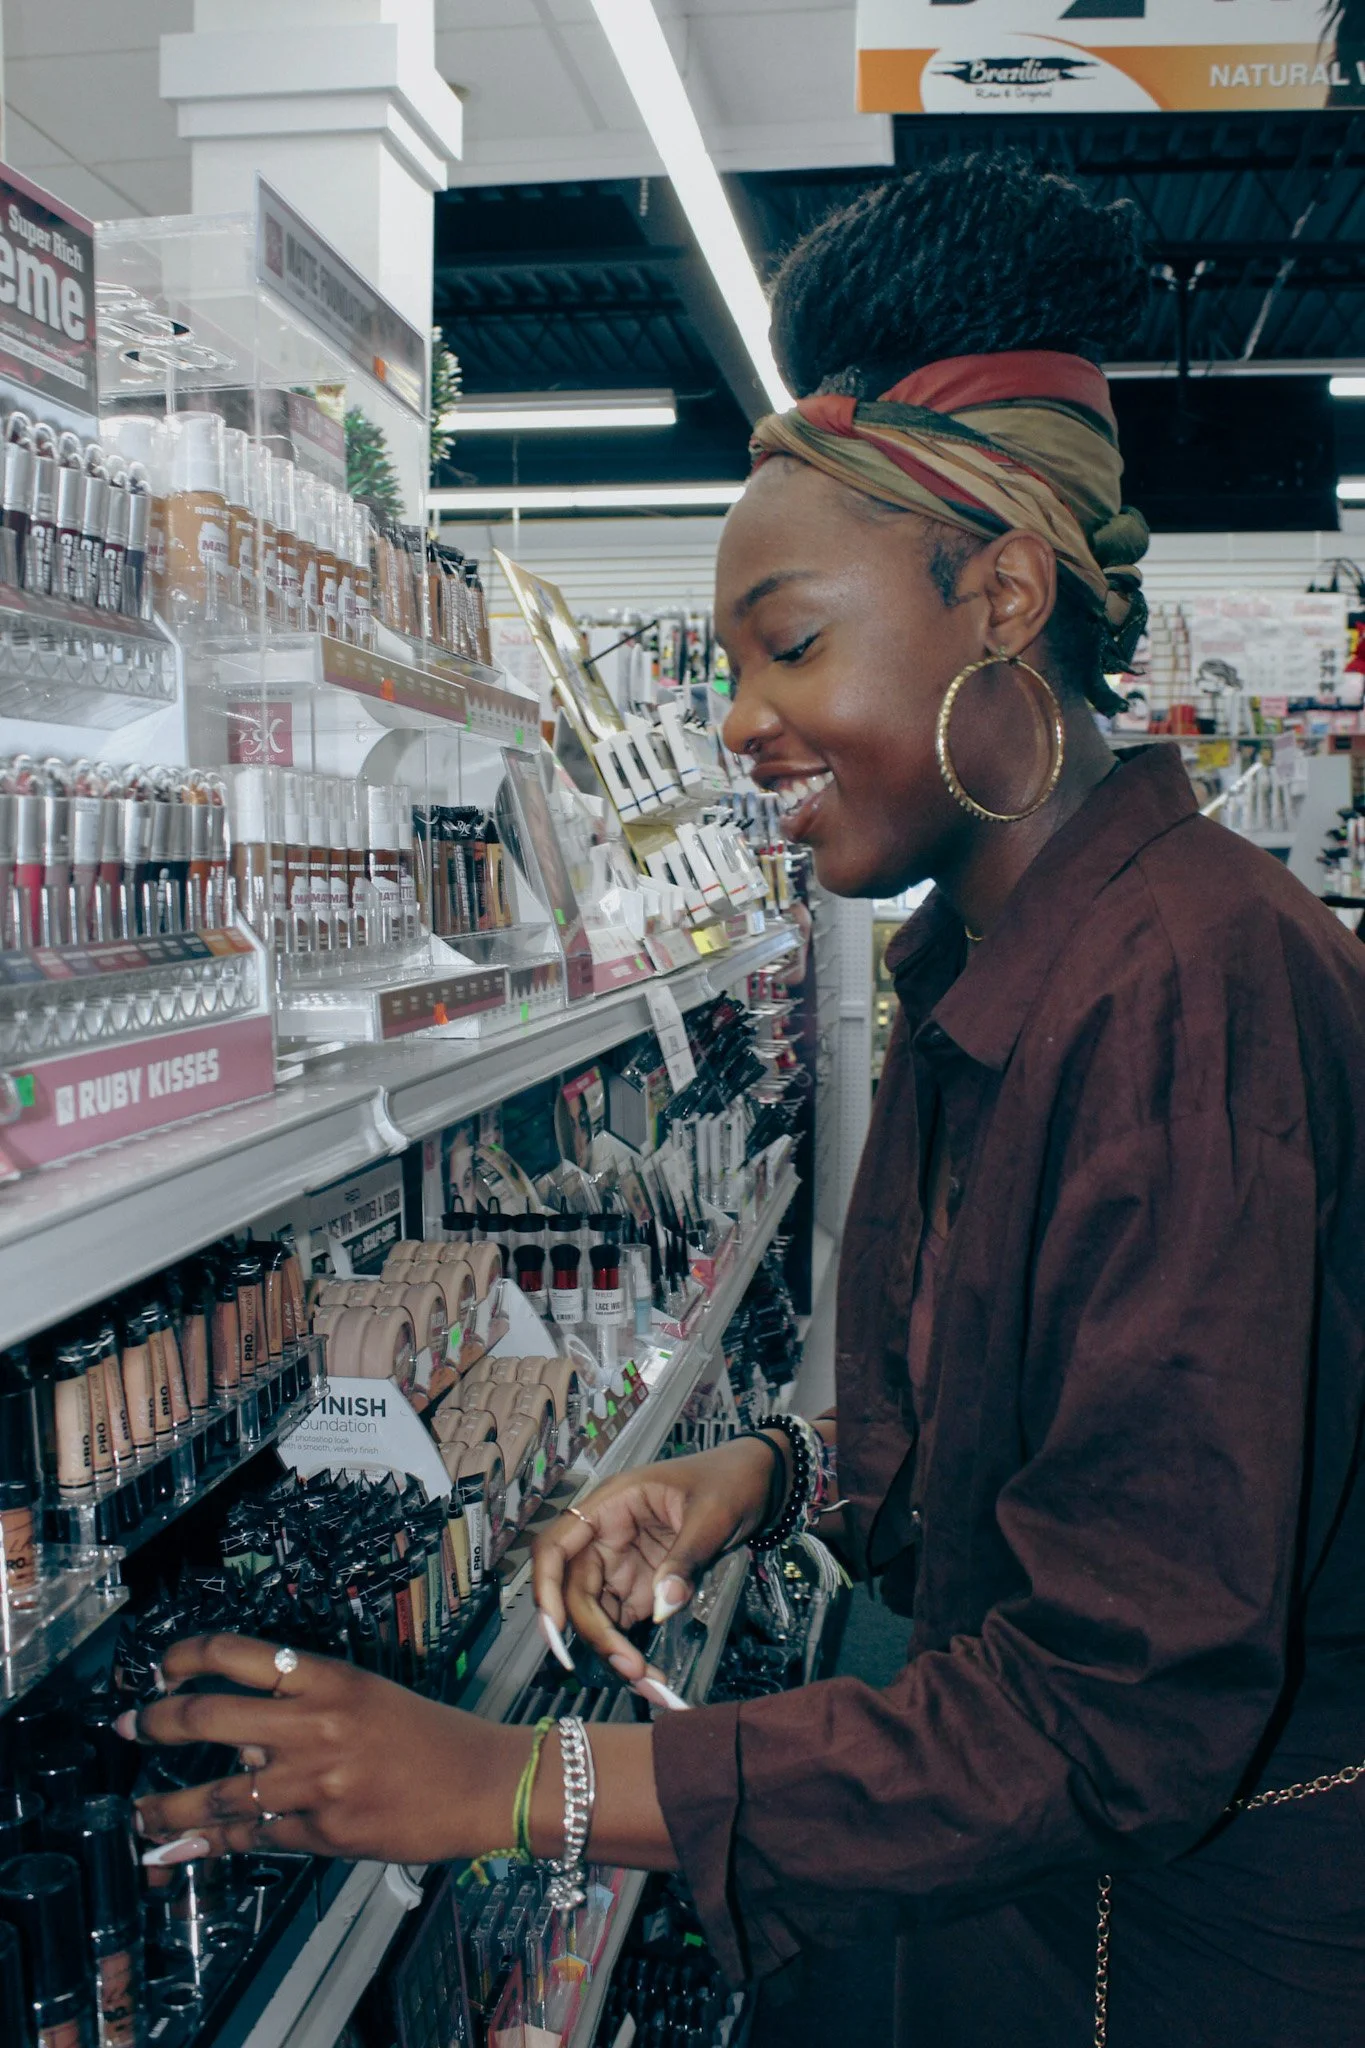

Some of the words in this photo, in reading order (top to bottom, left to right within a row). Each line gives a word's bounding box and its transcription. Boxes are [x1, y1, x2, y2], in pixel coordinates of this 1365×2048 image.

[970, 60, 1060, 83] Brazilian
[1210, 62, 1350, 87] NATURAL
[8, 204, 50, 250] Super
[52, 231, 84, 273] Rich
[78, 1066, 142, 1120] RUBY
[148, 1048, 219, 1099] KISSES
[305, 1396, 387, 1417] INISH
